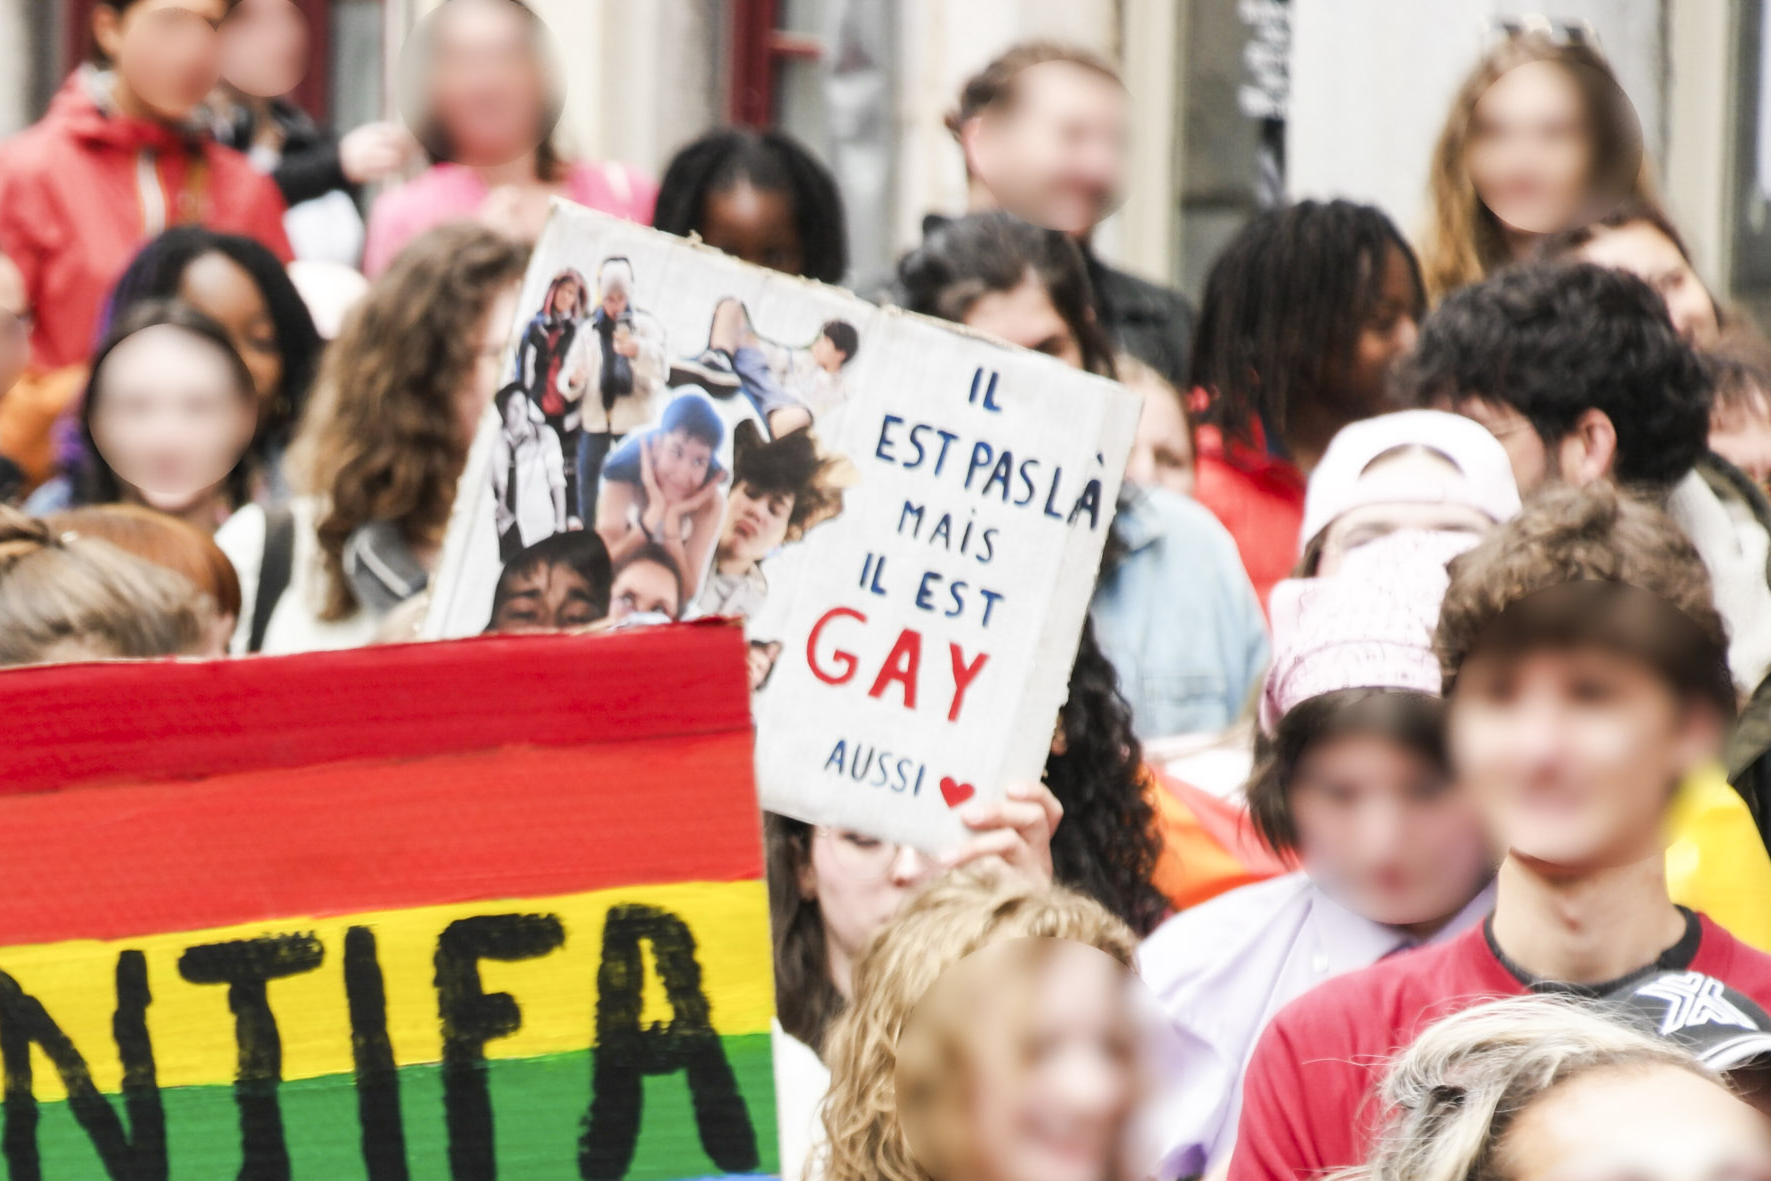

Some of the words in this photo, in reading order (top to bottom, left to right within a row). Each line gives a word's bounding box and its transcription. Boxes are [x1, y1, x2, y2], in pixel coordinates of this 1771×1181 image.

[968, 366, 1002, 412] IL
[875, 414, 961, 477] EST
[964, 440, 1039, 506] PAS
[1043, 452, 1106, 532] LÀ
[858, 553, 888, 596] IL
[915, 571, 1005, 628] EST
[806, 606, 990, 722] GAY
[824, 738, 926, 798] AUSSI
